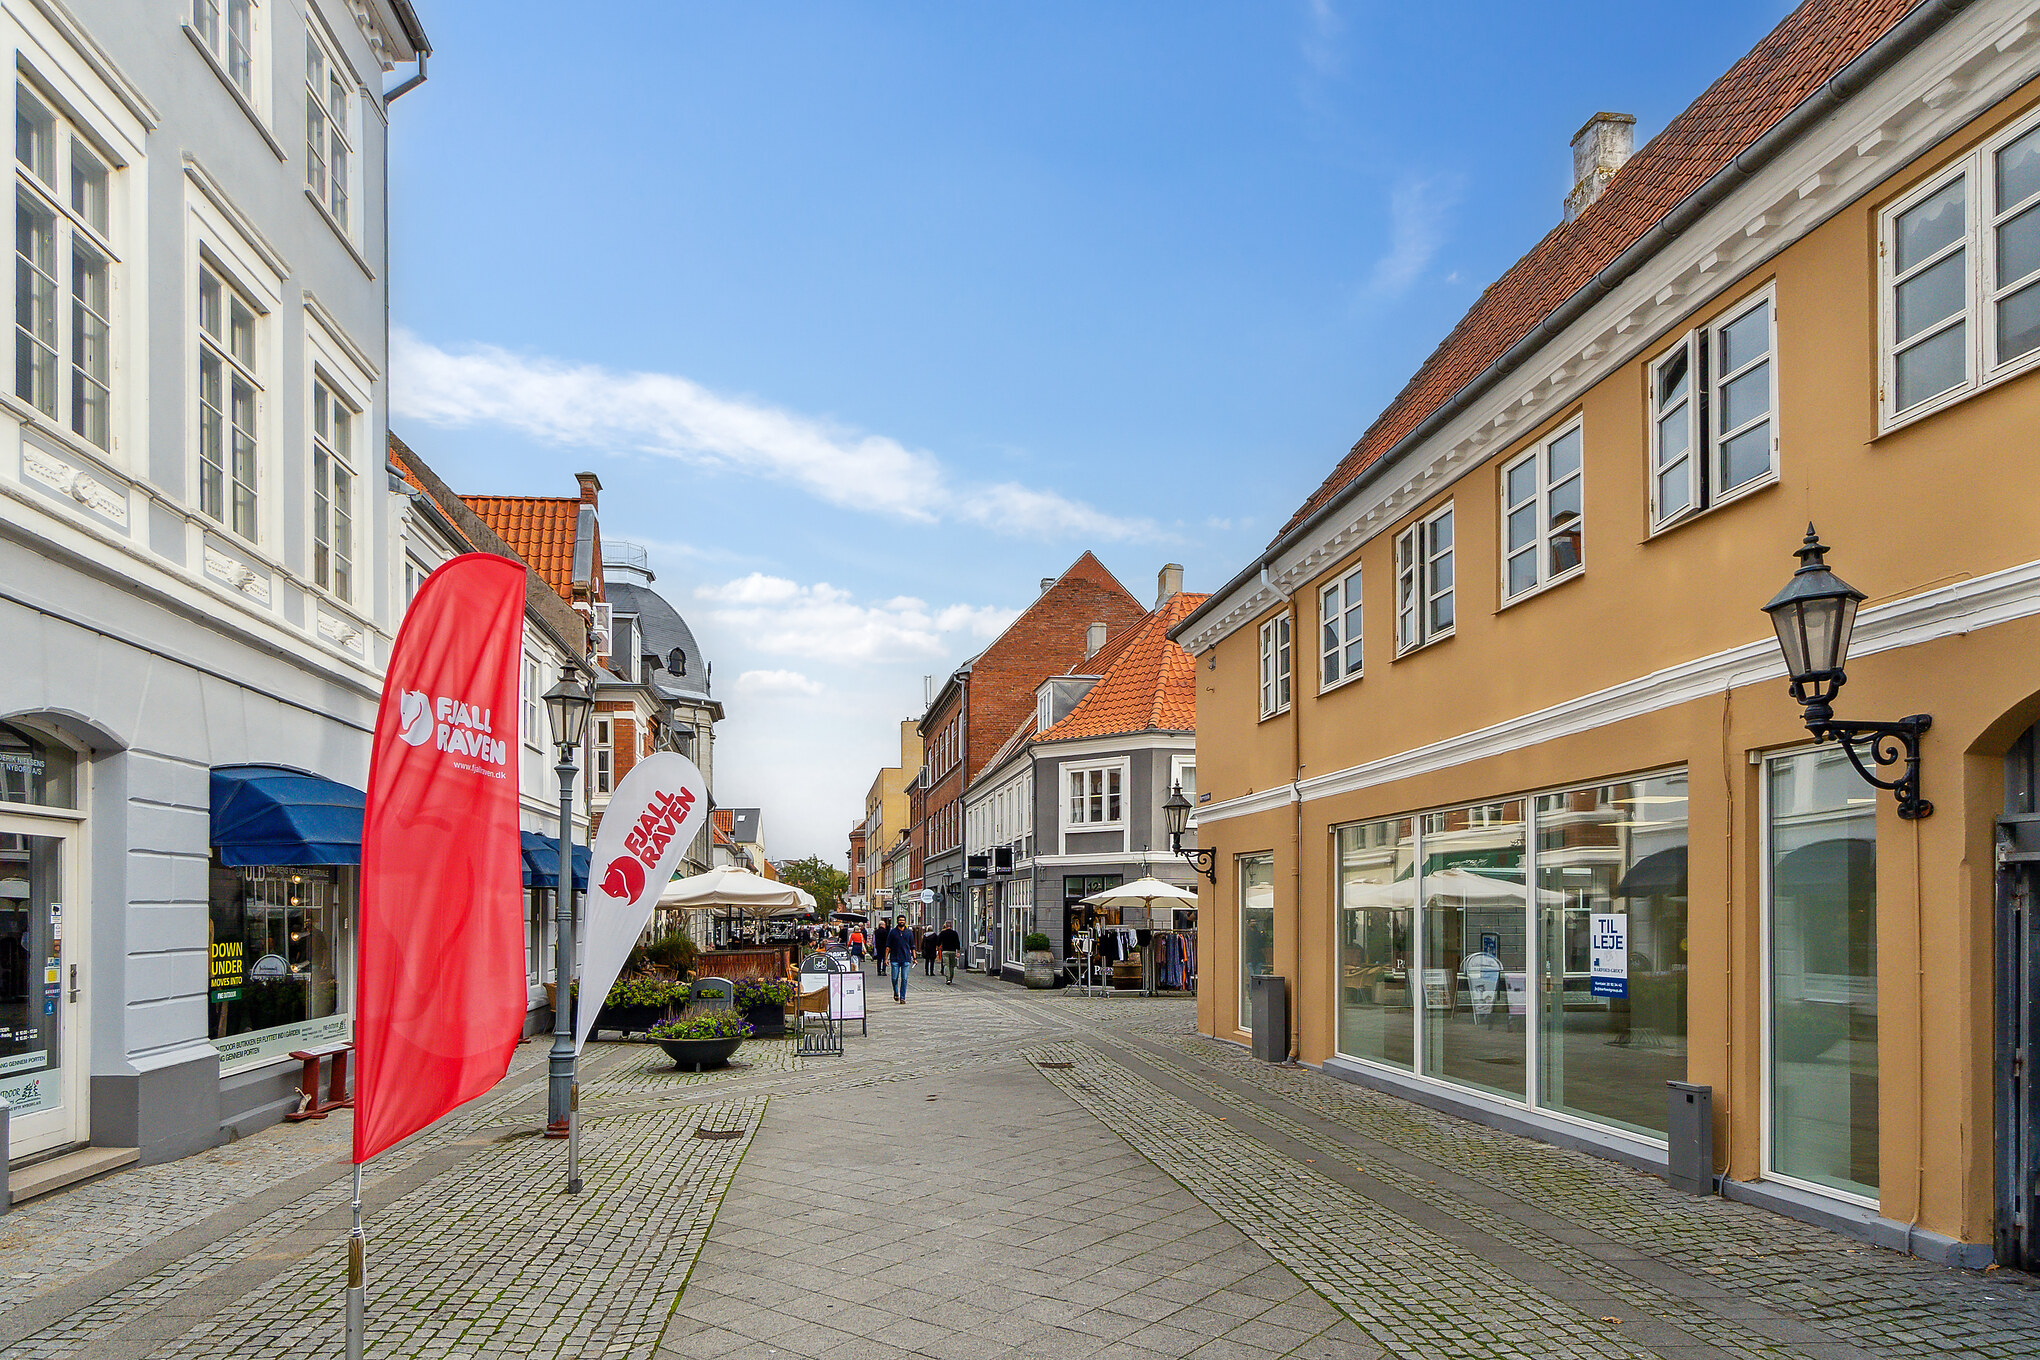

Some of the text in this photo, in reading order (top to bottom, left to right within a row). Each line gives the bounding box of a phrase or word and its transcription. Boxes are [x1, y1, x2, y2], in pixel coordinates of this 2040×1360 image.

[437, 697, 492, 733] FJÄLL
[437, 724, 506, 766] RÄVEN
[624, 790, 675, 857] FJÄLL
[640, 786, 696, 870] RÄVEN
[1598, 919, 1618, 934] TIL
[211, 942, 243, 958] DOWN
[1593, 934, 1624, 950] LEJE
[211, 960, 243, 976] UNDER
[210, 979, 230, 988] MOVES
